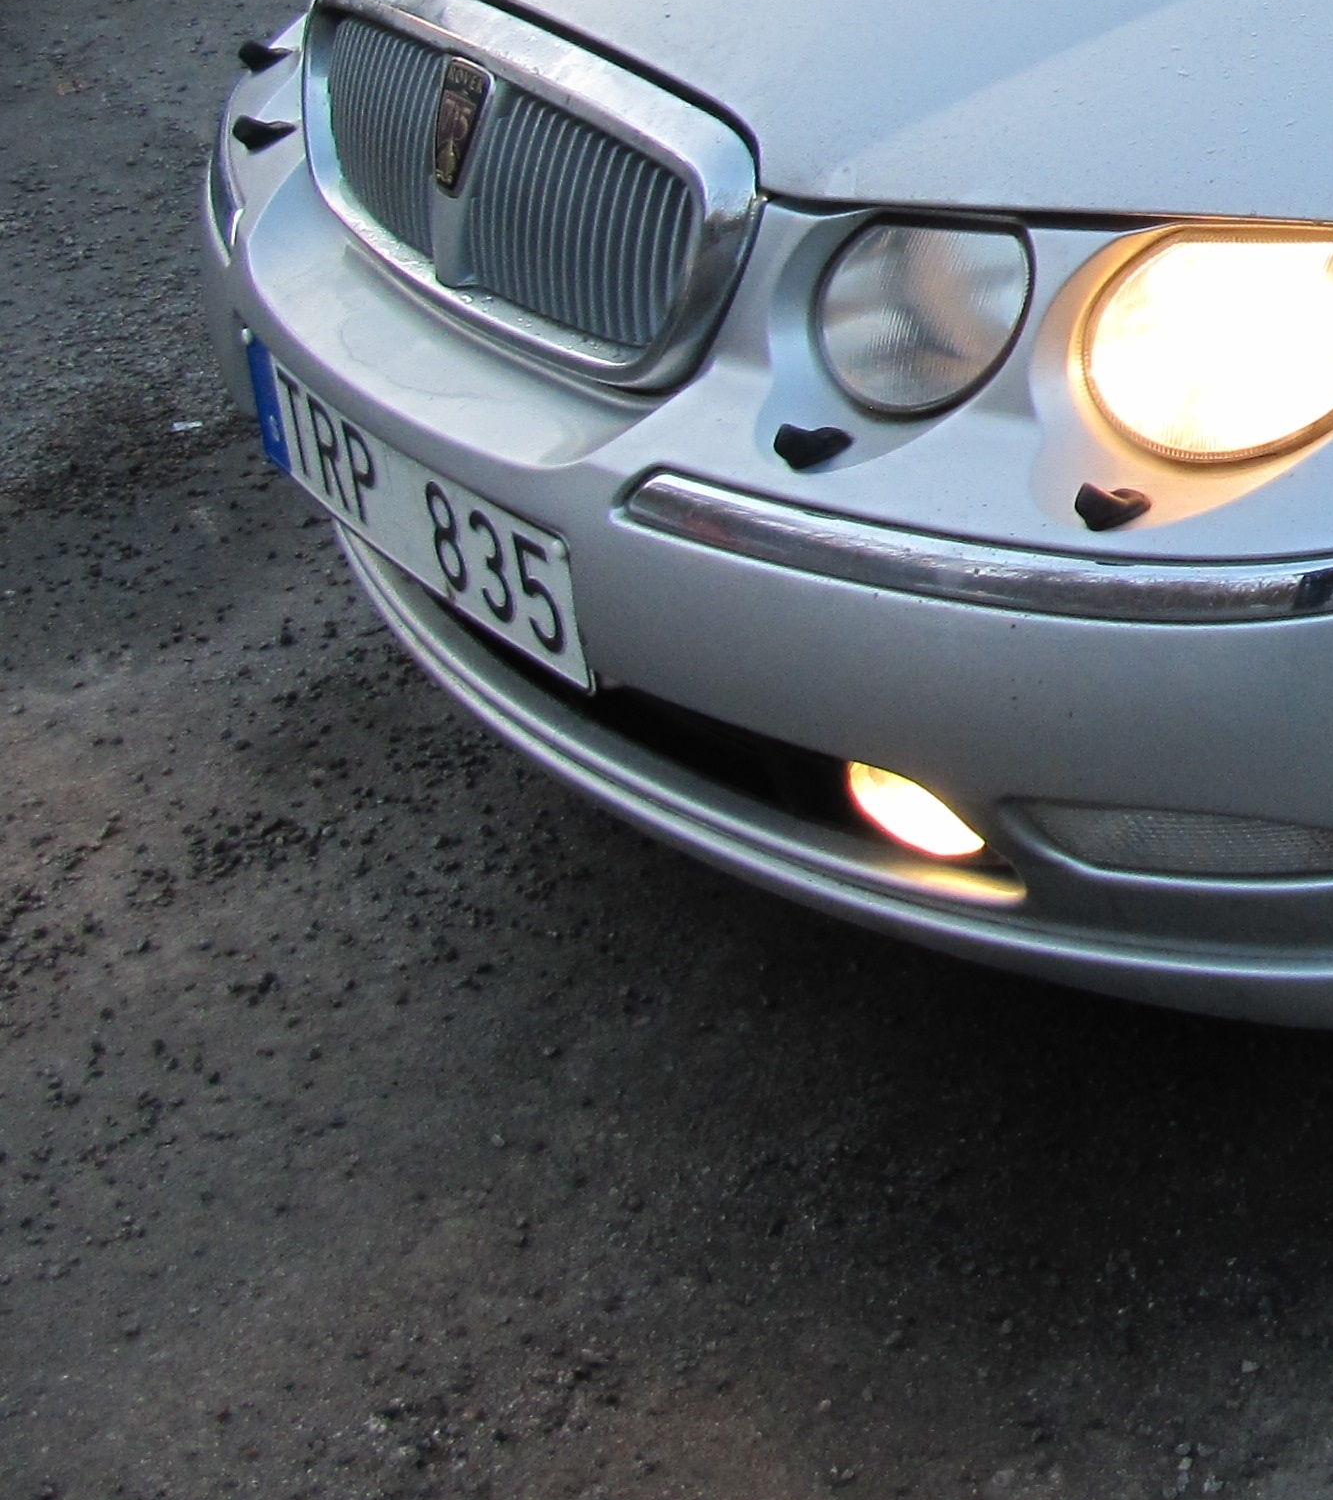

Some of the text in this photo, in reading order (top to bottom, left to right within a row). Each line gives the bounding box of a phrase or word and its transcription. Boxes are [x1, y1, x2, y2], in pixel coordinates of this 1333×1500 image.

[447, 64, 484, 95] ROVER
[276, 363, 567, 655] TRP 835
